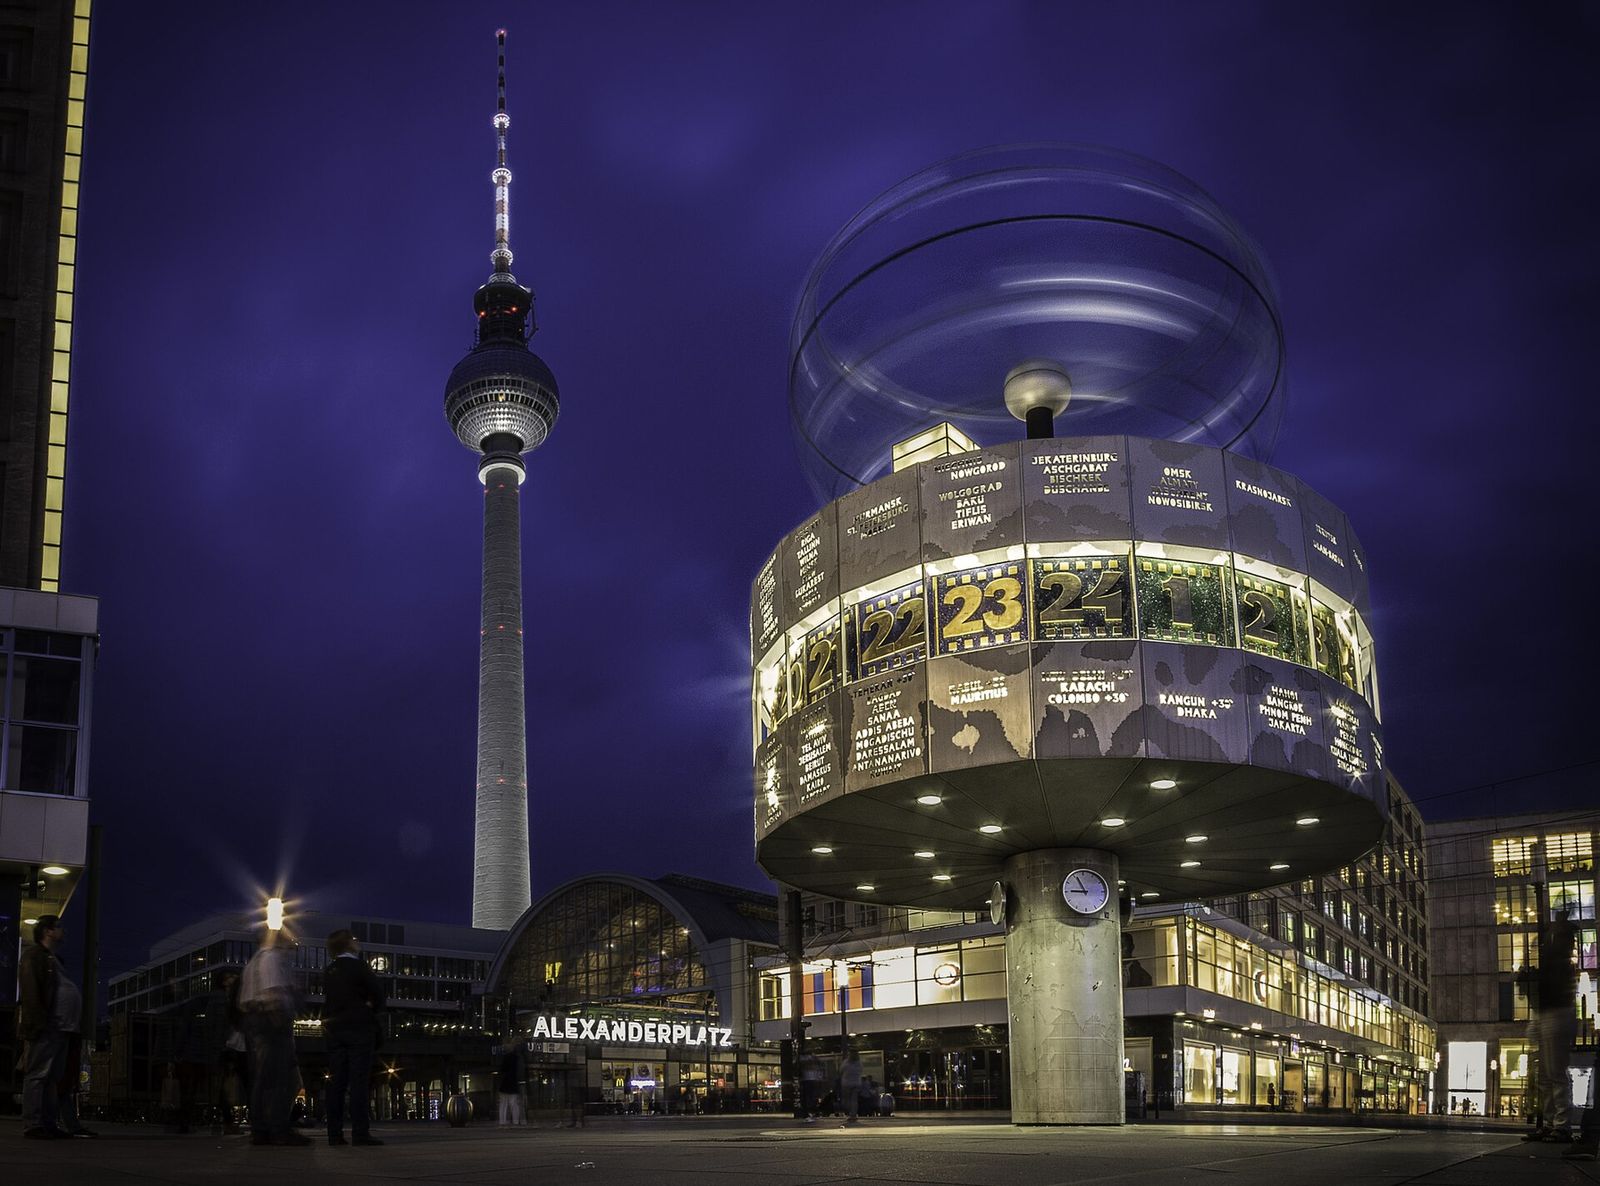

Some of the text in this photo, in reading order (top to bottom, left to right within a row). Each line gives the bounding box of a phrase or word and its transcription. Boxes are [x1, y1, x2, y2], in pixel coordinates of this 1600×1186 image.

[1032, 452, 1118, 465] JEKATERINBURG
[950, 461, 1006, 480] NOWGOROD
[1043, 463, 1108, 475] ASCHGABAT
[1050, 473, 1102, 484] BISCHKEK
[1163, 466, 1192, 479] OMSK
[938, 481, 1003, 501] WOLGOGRAD
[1235, 479, 1292, 507] KRASNOJARSK
[956, 494, 985, 509] BAKU
[1148, 495, 1214, 513] NOWOSIBIRSK
[955, 504, 987, 519] TIFLIS
[951, 513, 992, 530] ERIWAN
[796, 536, 821, 559] TALLINN
[801, 532, 816, 548] RIGA
[799, 548, 819, 567] WILNA
[1040, 571, 1124, 624] 24
[1162, 576, 1193, 627] 1
[942, 577, 1024, 638] 23
[1244, 591, 1279, 647] 2
[863, 598, 925, 664] 22
[950, 686, 1009, 705] MAURITIUS
[1060, 681, 1115, 693] KARACHI
[1271, 685, 1298, 701] HANOI
[1048, 692, 1101, 704] COLOMBO
[1159, 693, 1206, 707] RANGUN
[1266, 695, 1304, 713] BANGKOK
[867, 709, 901, 726] SANAA
[1177, 706, 1218, 720] DHAKA
[1259, 703, 1289, 720] PHNOM
[1291, 712, 1313, 727] PENH
[855, 715, 915, 741] ADDIS ABEBA
[1268, 717, 1307, 736] JAKARTA
[855, 726, 915, 751] MOGADISCHU
[798, 742, 832, 767] JERUSALEM
[856, 737, 915, 762] DARESSALAM
[804, 755, 825, 774] BEIRUT
[852, 746, 921, 773] ANTANANARIVO
[799, 763, 832, 787] DAMASKUS
[533, 1016, 733, 1047] ALEXANDERPLATZ
